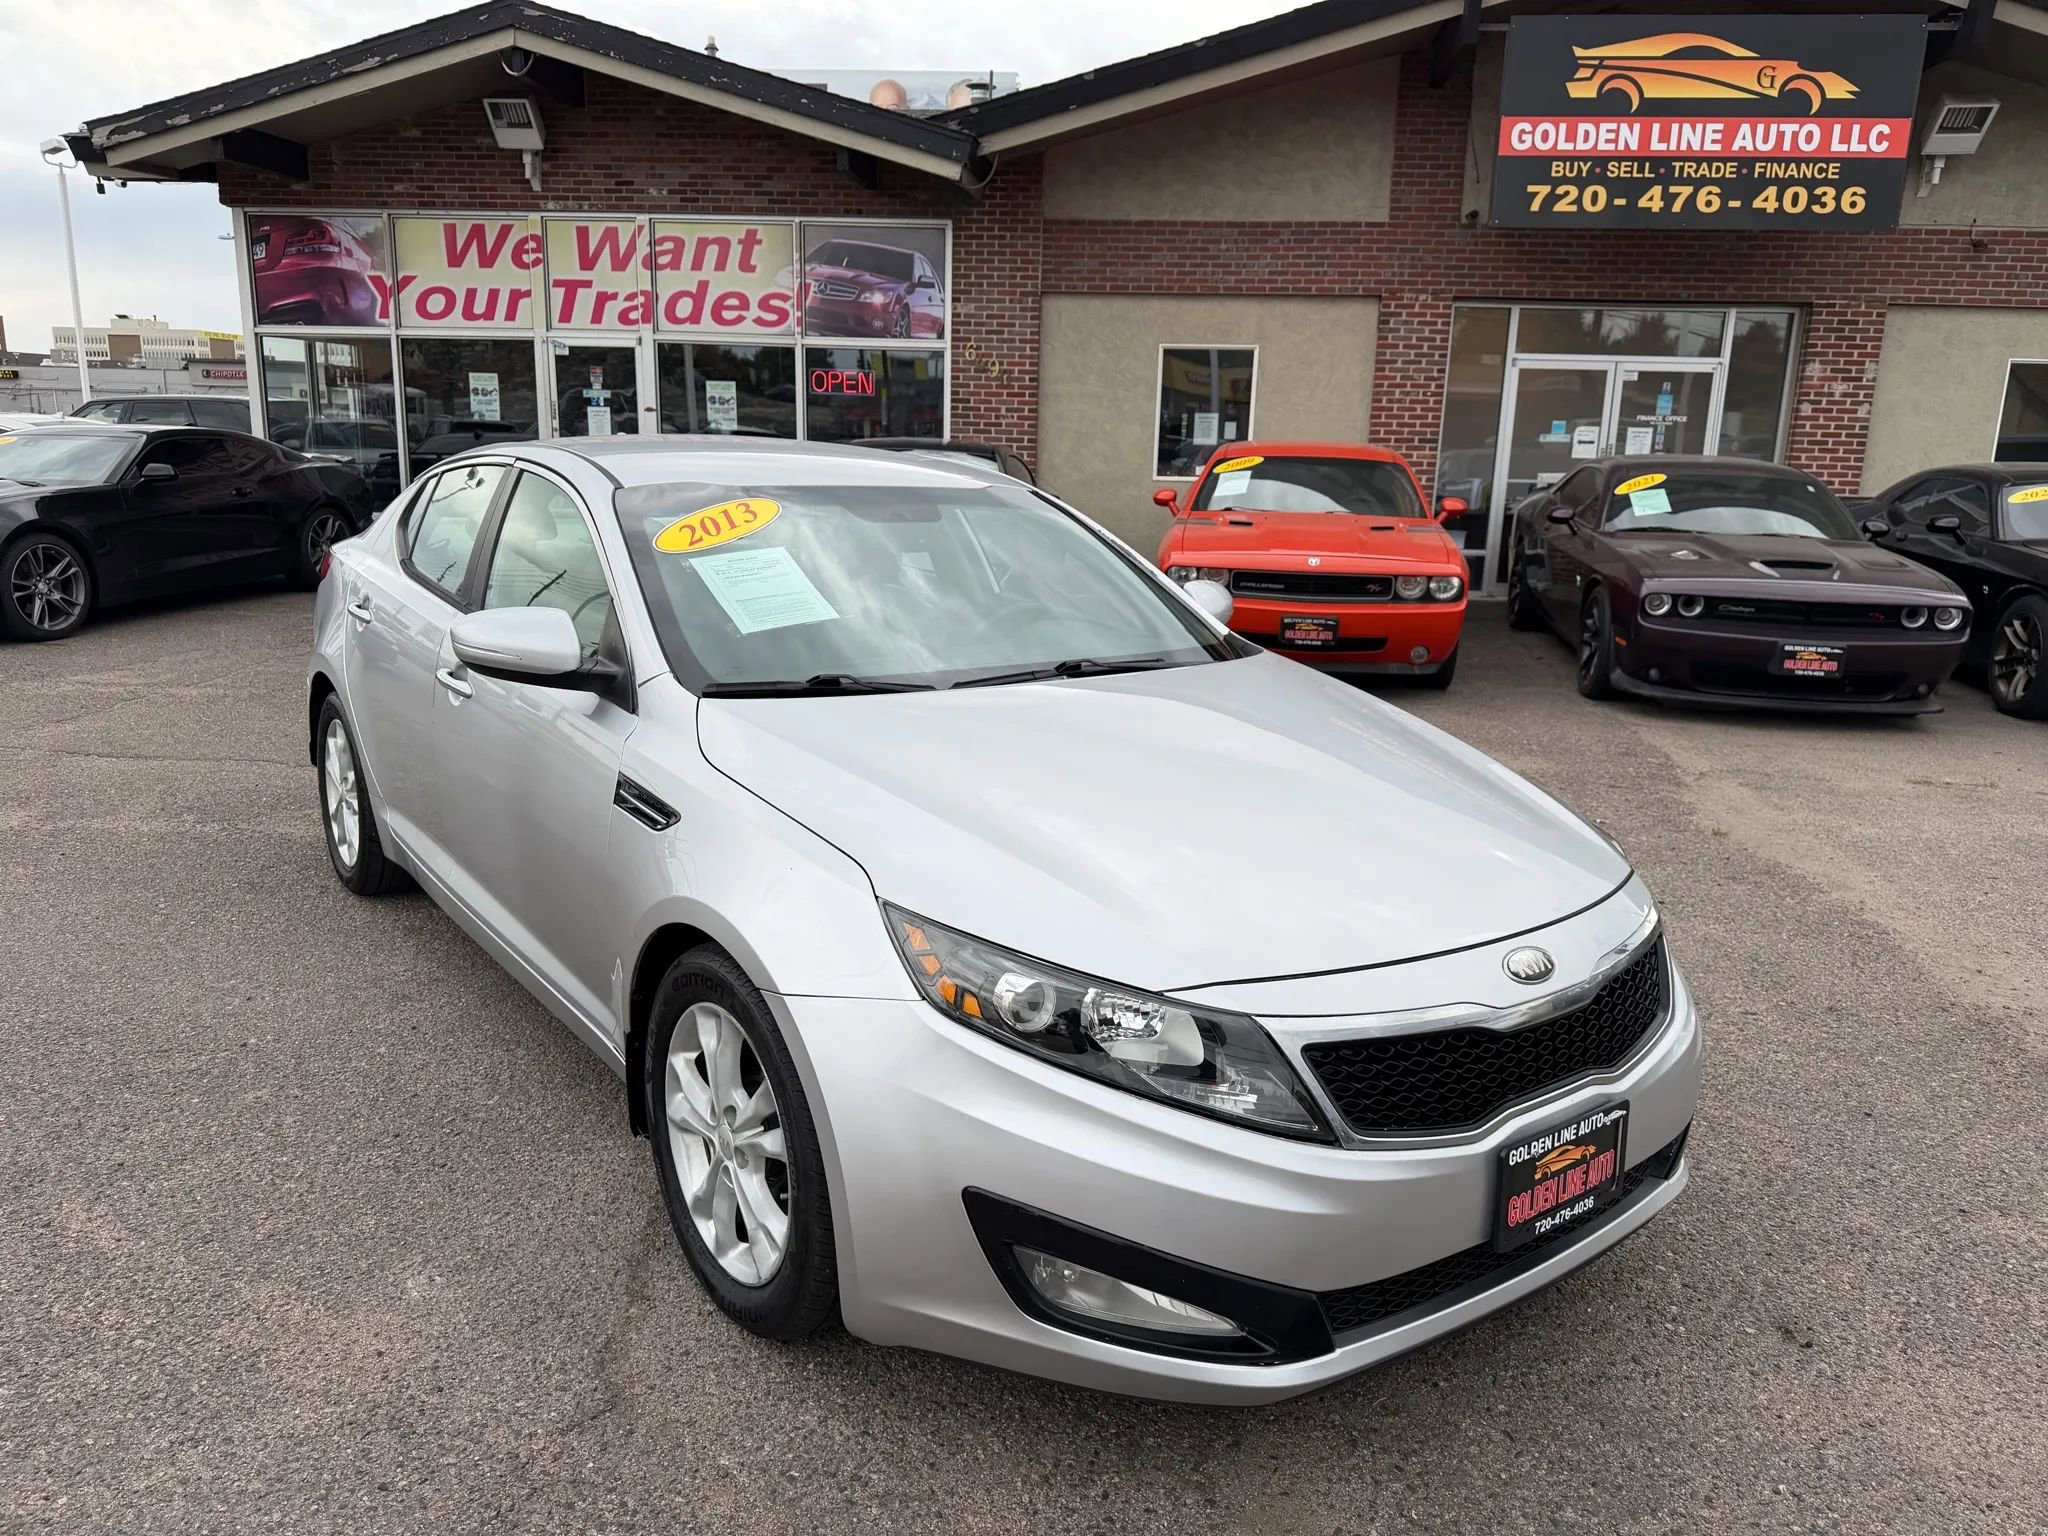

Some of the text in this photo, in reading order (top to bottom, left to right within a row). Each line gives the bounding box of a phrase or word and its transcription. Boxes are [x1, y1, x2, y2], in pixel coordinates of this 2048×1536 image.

[1510, 122, 1892, 153] GOLDEN LINE AUTO LLC
[1551, 161, 1840, 179] BUY SELL TRADE FINANCE
[442, 223, 763, 273] We Want
[367, 275, 812, 327] Your Trades!
[812, 370, 873, 394] OPEN
[1627, 476, 1654, 491] 2021
[2022, 489, 2048, 500] 202
[679, 502, 758, 547] 2013
[1509, 1112, 1604, 1166] GOLDEN LINE AUTO
[1507, 1149, 1615, 1227] GOLDEN LINE AUTO
[1535, 1196, 1595, 1235] 720-476-4036
